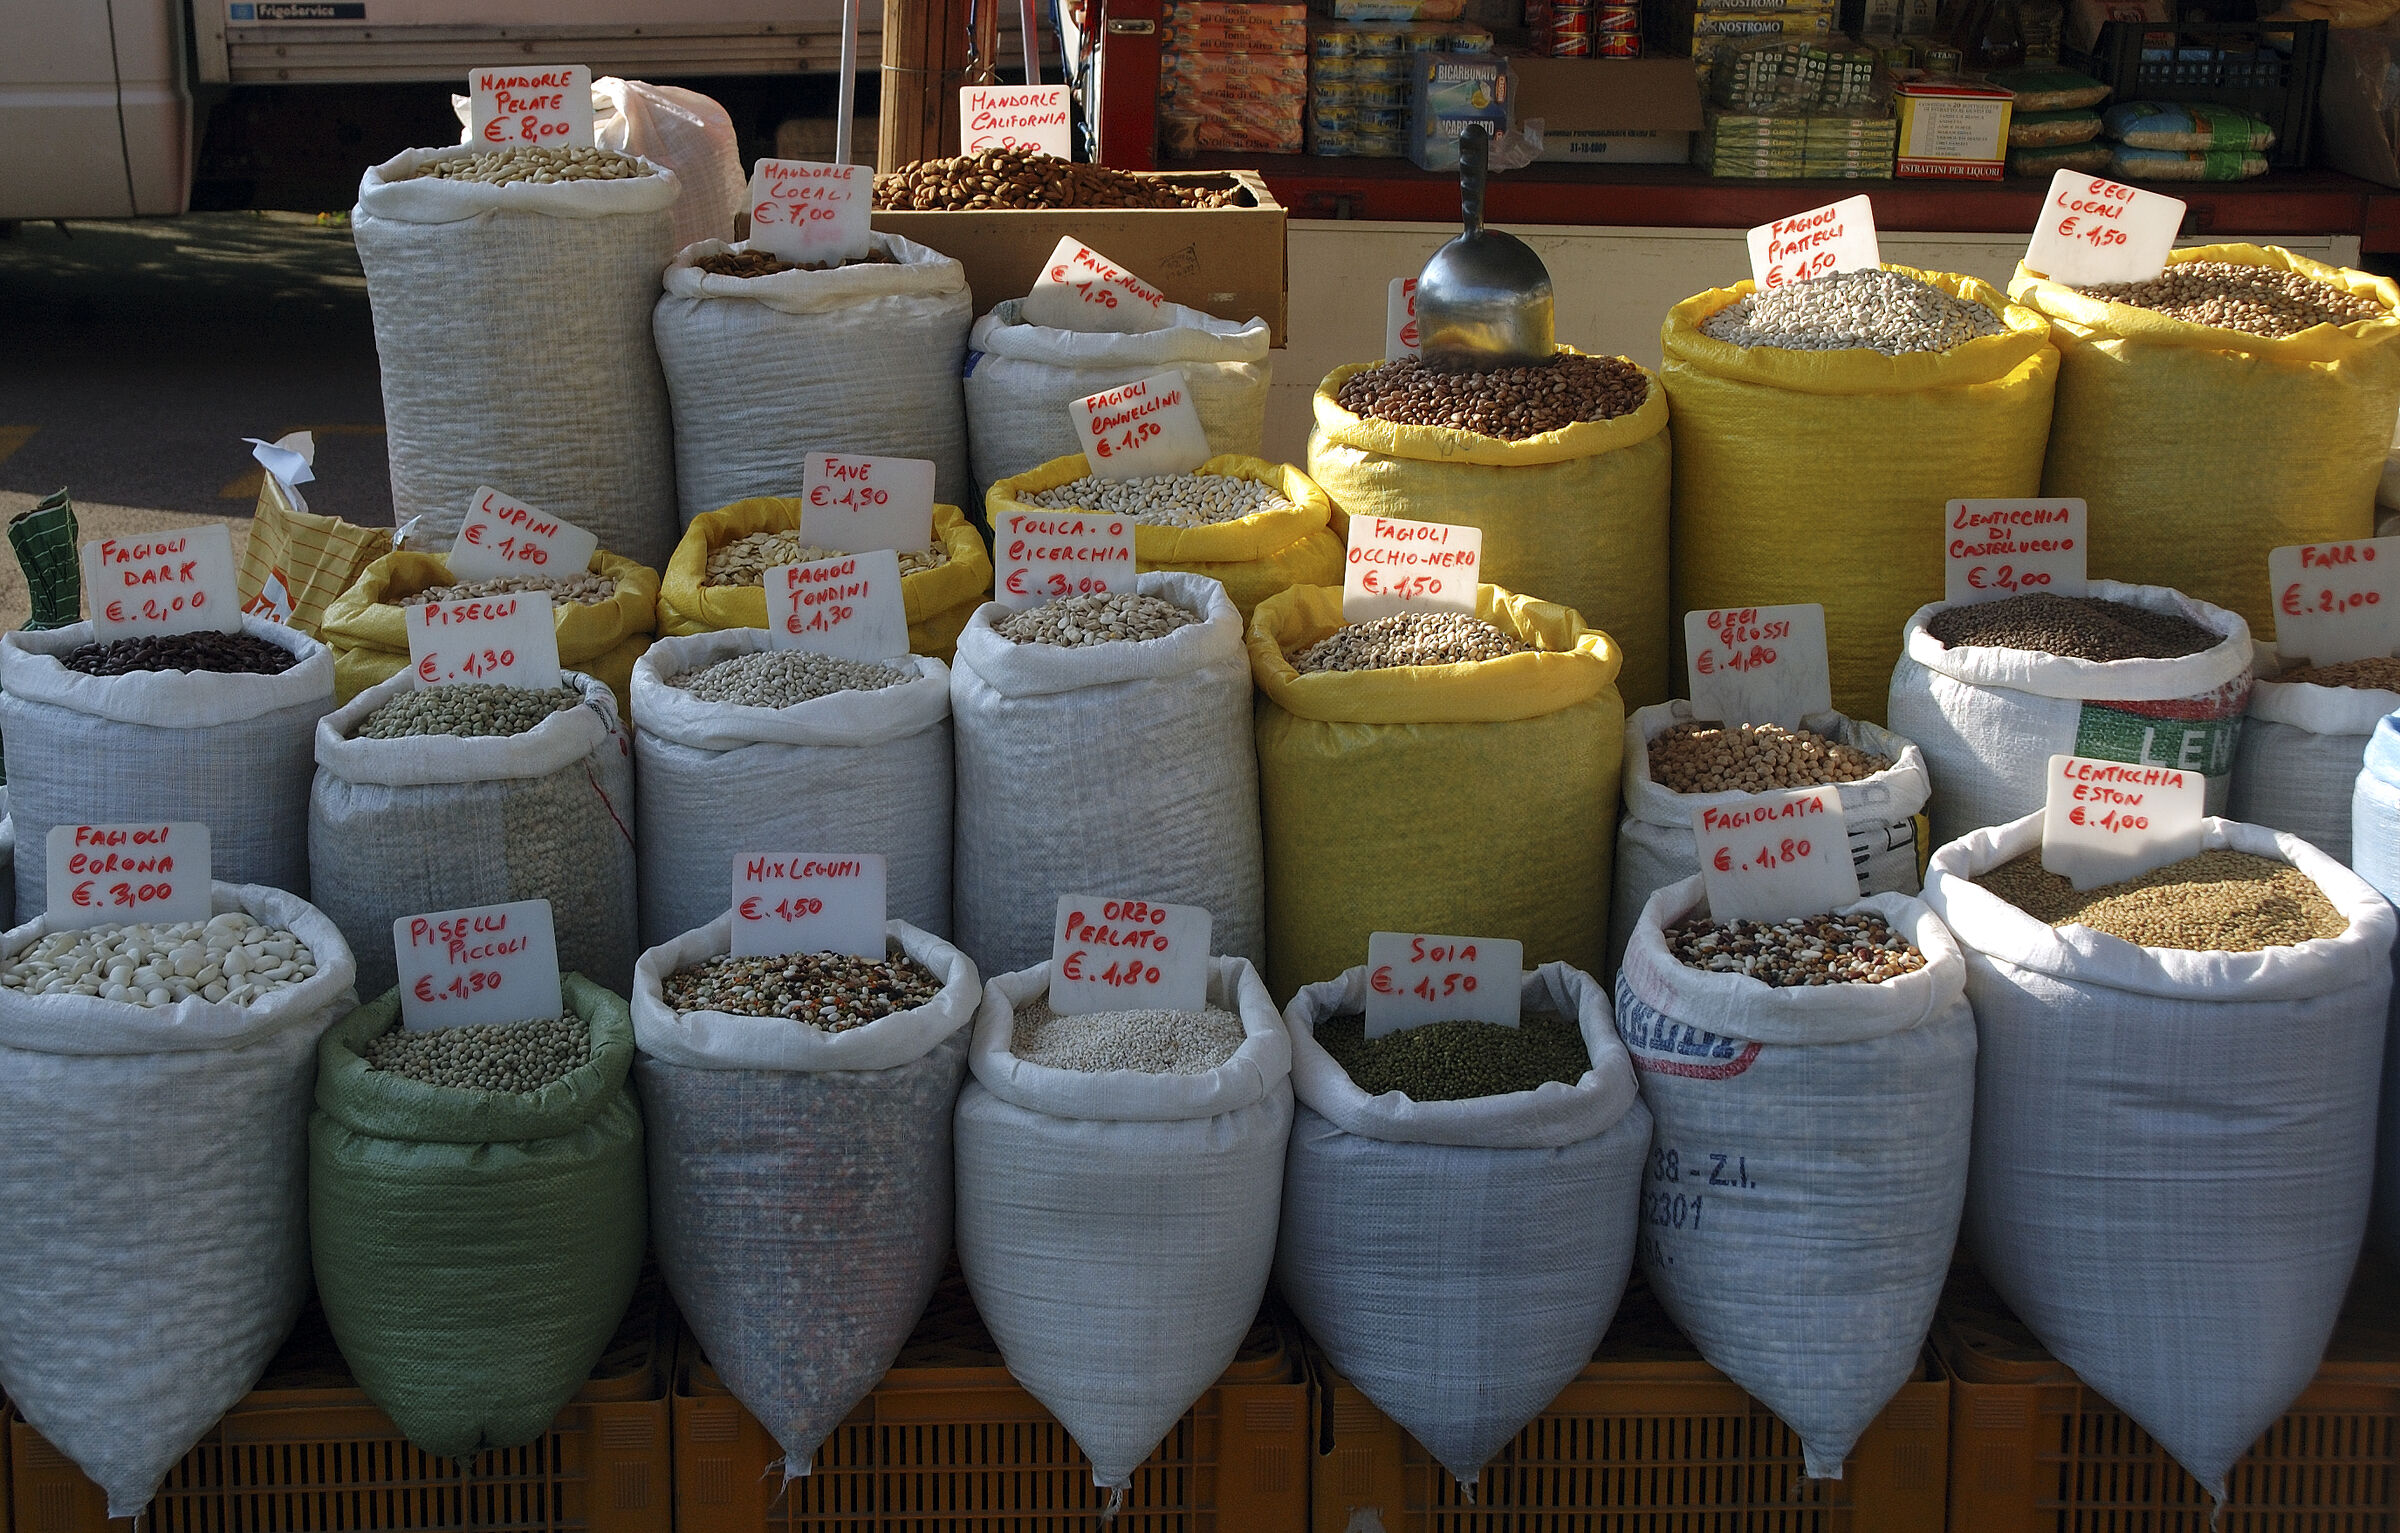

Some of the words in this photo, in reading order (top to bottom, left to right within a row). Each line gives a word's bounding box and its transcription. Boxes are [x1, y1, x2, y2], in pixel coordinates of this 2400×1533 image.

[261, 4, 336, 19] FrigoService
[1719, 21, 1780, 32] NOSTROMO
[481, 72, 572, 91] MANDORLE
[1438, 65, 1497, 81] BICARBONATO
[495, 92, 562, 113] PELATE
[972, 92, 1060, 111] MANDORLE
[971, 112, 1066, 131] CALIFORNIA
[765, 162, 855, 181] MANDORLE
[1901, 163, 1946, 175] ESTRATTINI
[1949, 165, 1964, 176] PER
[1967, 166, 2000, 178] LIQUORI
[770, 182, 851, 201] LOCALI
[2089, 179, 2135, 205] CECI
[2057, 191, 2123, 220] LOCALI
[1772, 208, 1837, 240] FAGIOLI
[1768, 224, 1843, 264] PIATTELLI
[1087, 381, 1146, 413] FAGIOLI
[825, 458, 872, 482] FAVE
[482, 494, 559, 539] LUPINI
[1952, 504, 2070, 530] LENTICCHIA
[1375, 518, 1449, 545] FAGIOLI
[1989, 527, 2011, 541] DI
[101, 538, 186, 566] FAGIOLI
[1009, 541, 1129, 561] CICERCHIA
[1349, 547, 1475, 568] OCCHIO-NERO
[2301, 546, 2376, 570] FARRO
[124, 560, 198, 587] DARK
[787, 560, 855, 589] FAGIOLI
[788, 581, 869, 611] TONDINI
[425, 599, 518, 627] PISELLI
[1707, 608, 1757, 629] CECI
[1719, 621, 1790, 649] GROSSI
[2064, 760, 2183, 789] LENTICCHIA
[2073, 784, 2144, 806] ESTON
[1703, 796, 1824, 833] FAGIOLATA
[75, 826, 169, 847] FAGIOLI
[69, 854, 173, 874] CORONA
[1104, 901, 1166, 925] ORZO
[410, 914, 506, 947] PISELLI
[1065, 911, 1168, 951] PERLATO
[448, 936, 526, 965] PICCOLI
[1410, 938, 1477, 963] SOIA
